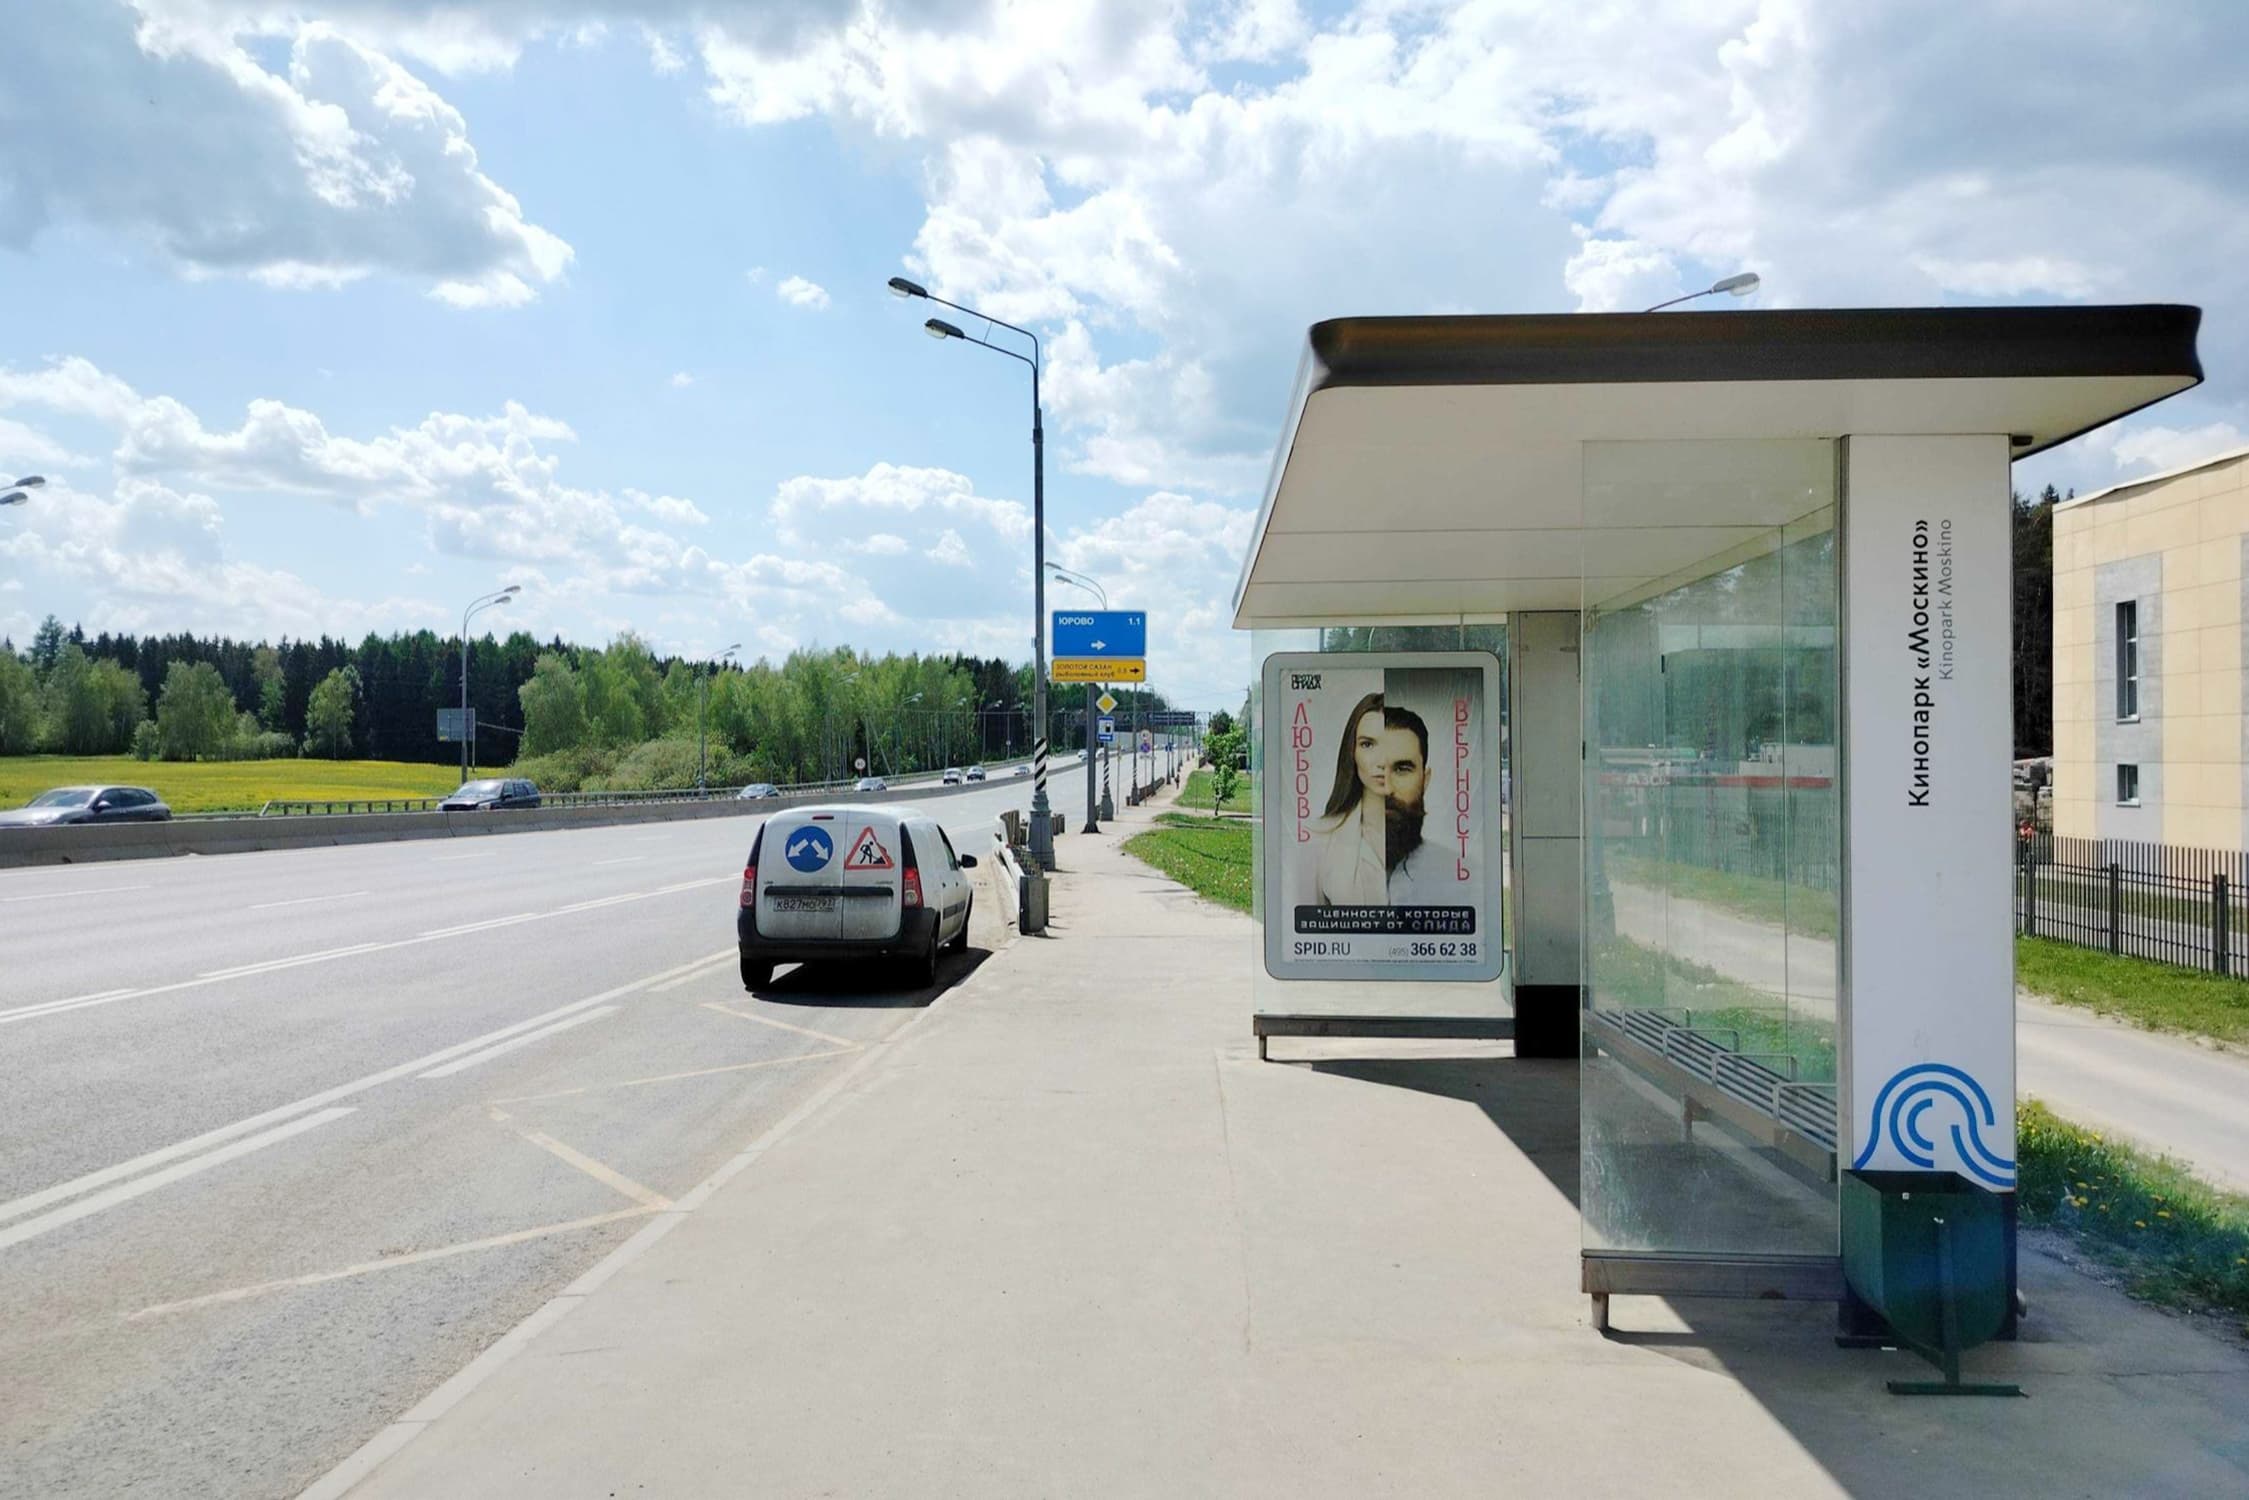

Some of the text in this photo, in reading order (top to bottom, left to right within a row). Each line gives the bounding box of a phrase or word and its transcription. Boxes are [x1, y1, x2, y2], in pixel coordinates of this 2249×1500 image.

[1937, 519, 1957, 680] Kinopark Moskino
[1058, 616, 1095, 626] ЮРОВО
[1908, 519, 1935, 807] Кинопарк «Москино»
[1387, 921, 1404, 929] ОТ
[1411, 919, 1471, 931] СПИДА
[1294, 942, 1351, 956] SPID.RU
[1410, 942, 1436, 956] 366
[1440, 942, 1456, 956] 62
[1460, 942, 1477, 956] 38
